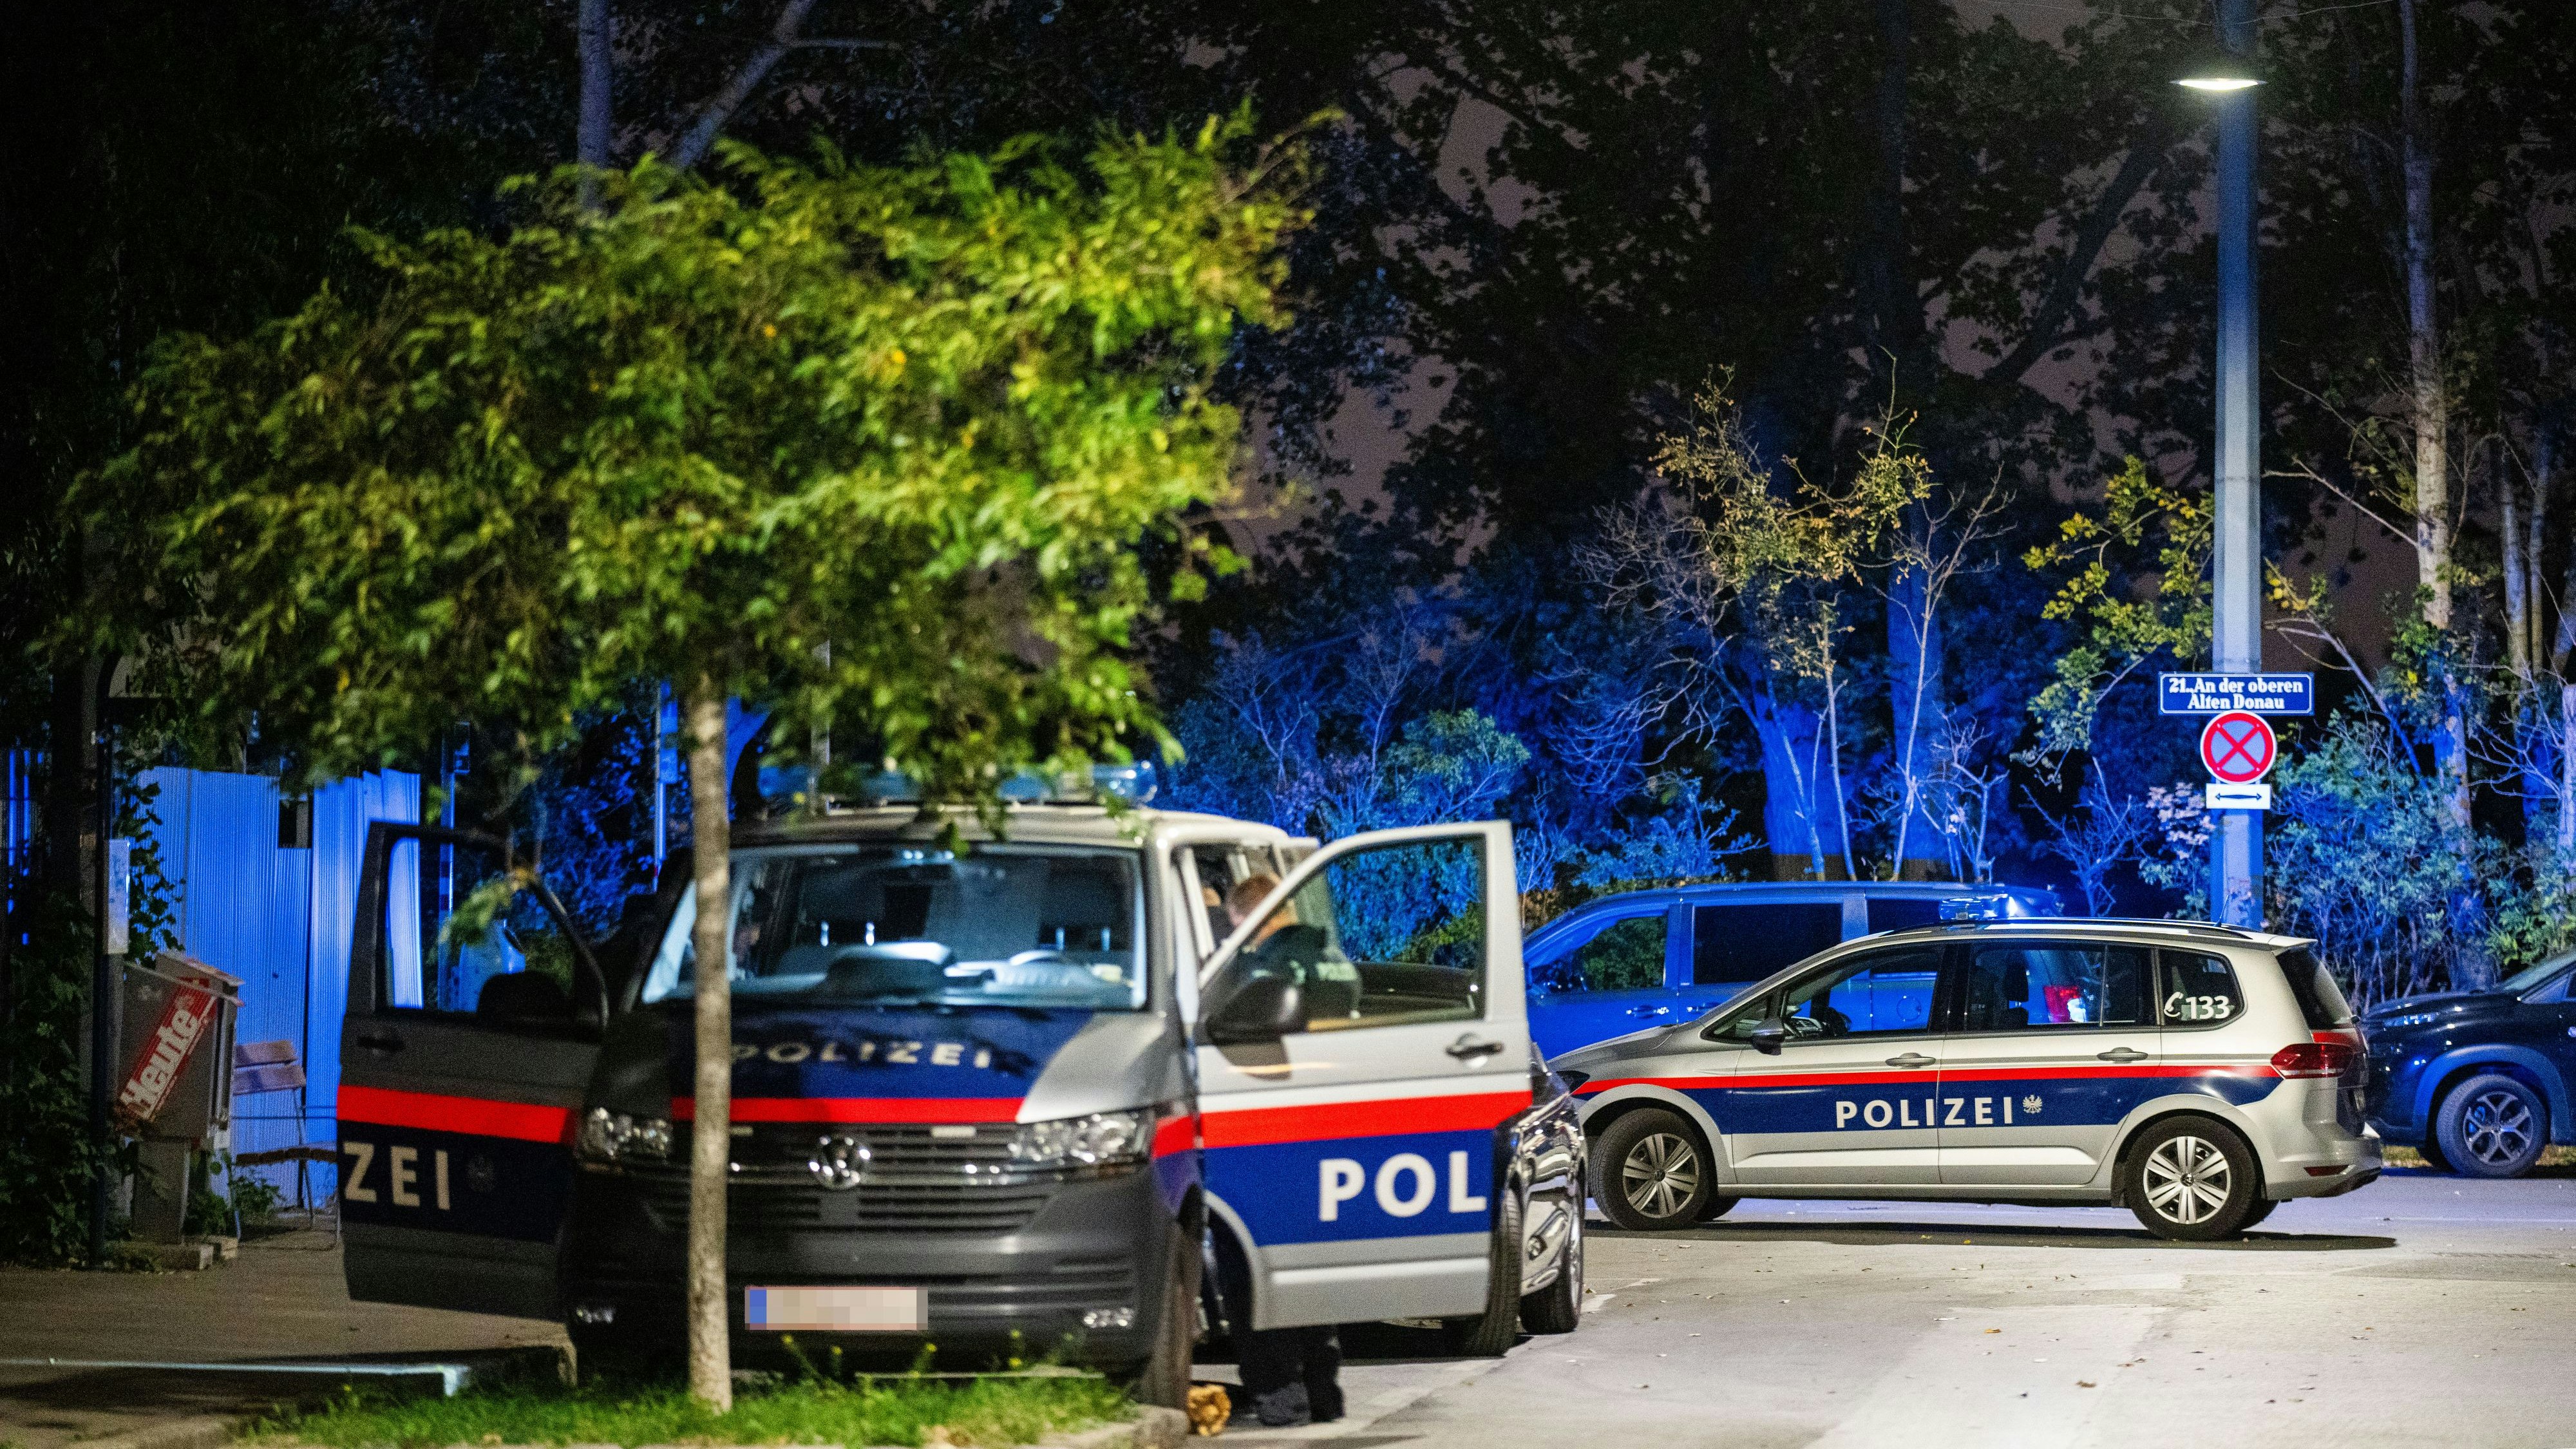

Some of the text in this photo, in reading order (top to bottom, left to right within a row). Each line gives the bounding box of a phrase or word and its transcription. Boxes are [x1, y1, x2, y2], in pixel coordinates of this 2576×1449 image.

[2219, 677, 2245, 693] der
[2248, 677, 2303, 693] oberen
[2187, 693, 2285, 709] Alten Donau
[2185, 995, 2230, 1019] 133
[119, 1009, 199, 1119] Heute
[732, 1041, 992, 1068] POLIZEI
[1835, 1096, 2014, 1129] POLIZEI
[343, 1141, 450, 1211] ZEI
[1318, 1151, 1487, 1222] POL
